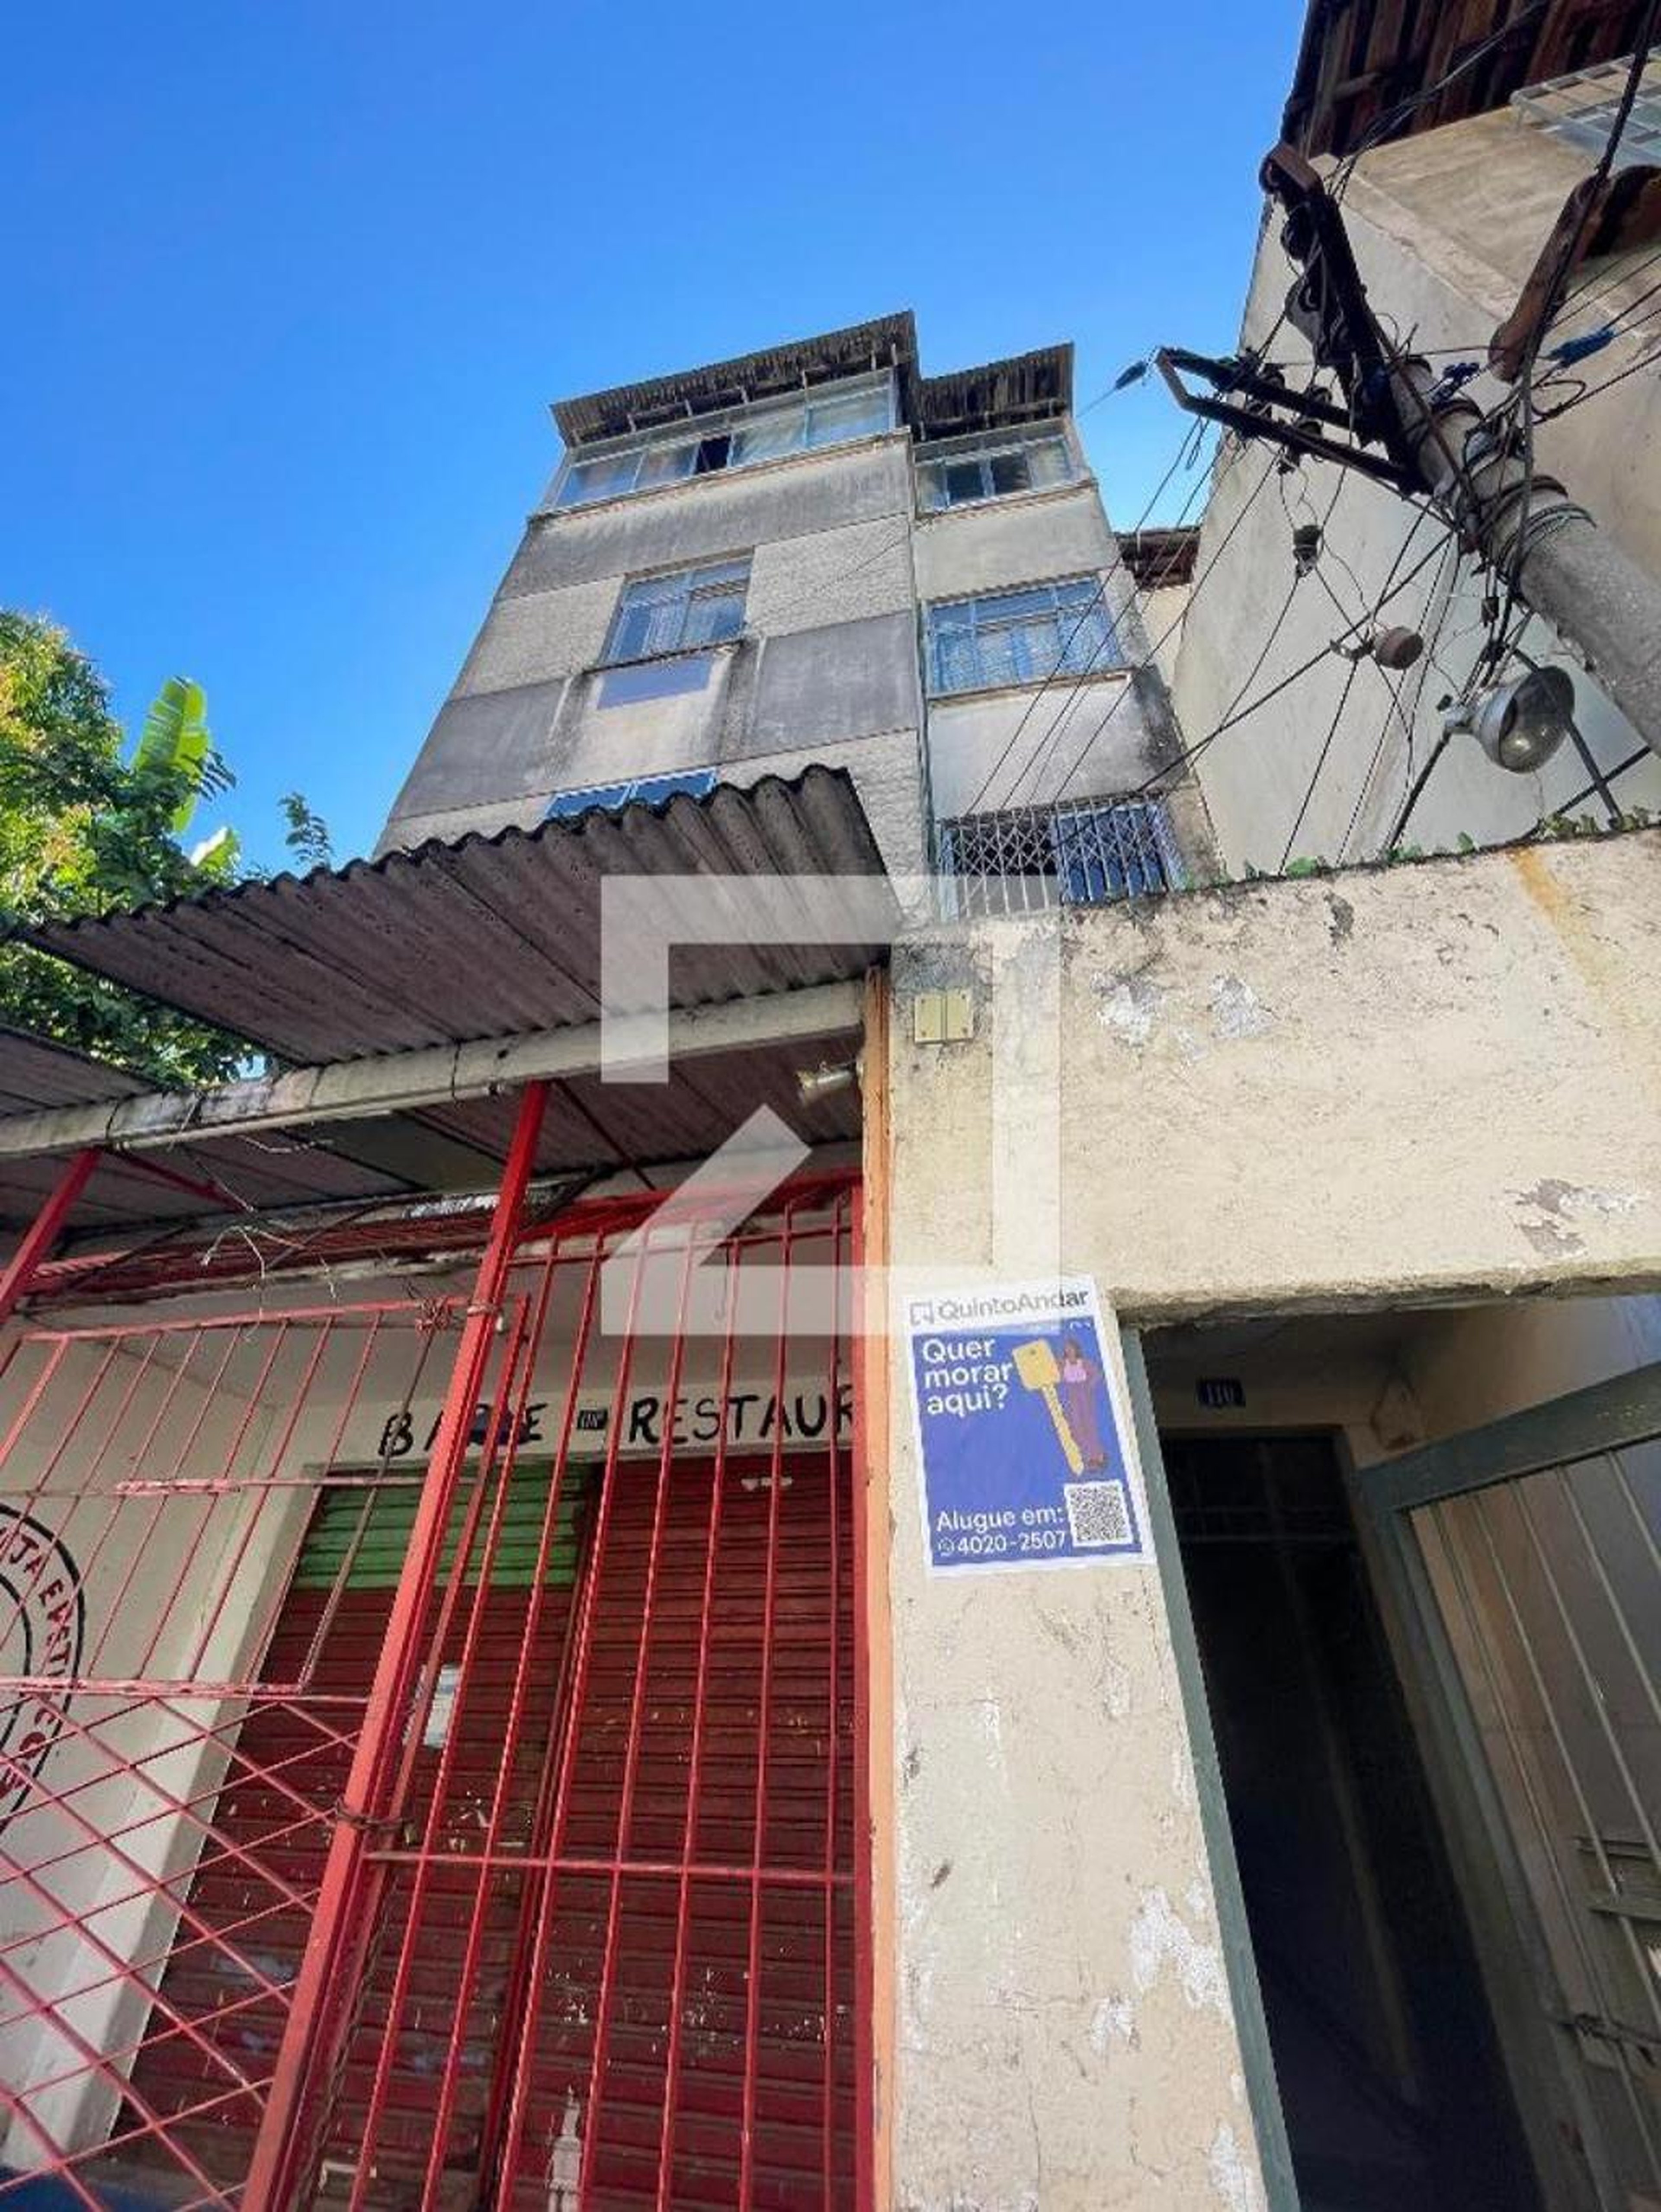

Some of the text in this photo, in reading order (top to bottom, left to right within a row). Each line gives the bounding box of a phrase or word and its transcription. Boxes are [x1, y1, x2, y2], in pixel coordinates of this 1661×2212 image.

[937, 1288, 1089, 1321] QuintoAndar
[923, 1339, 995, 1363] Quer
[925, 1364, 1013, 1388] morar
[928, 1383, 1008, 1418] aqui?
[936, 1508, 1065, 1533] Alugue em:
